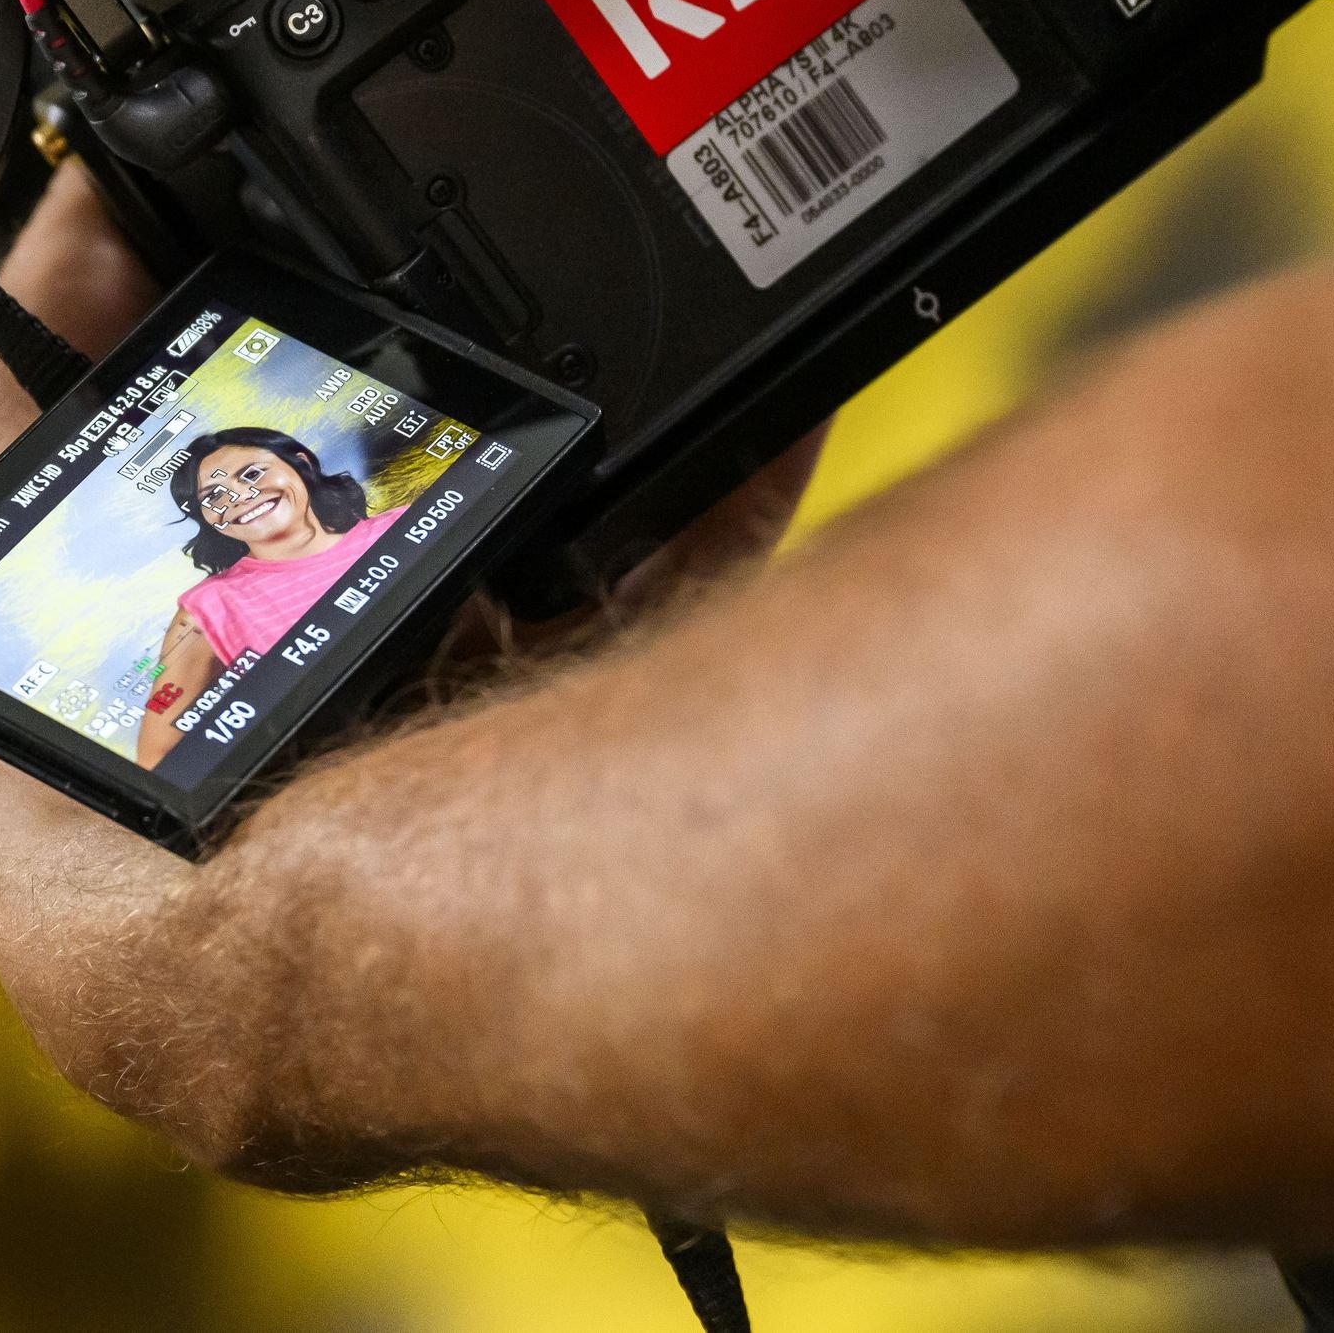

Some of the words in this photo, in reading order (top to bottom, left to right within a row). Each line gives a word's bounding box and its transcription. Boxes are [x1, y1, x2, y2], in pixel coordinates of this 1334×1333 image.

[288, 4, 323, 34] C3
[714, 72, 785, 133] ALPHA
[831, 15, 860, 43] 4K
[728, 87, 798, 148] 707610
[190, 310, 222, 335] 68%
[315, 368, 352, 402] AWB
[351, 387, 378, 412] DRO
[58, 439, 89, 463] 50p
[147, 365, 167, 383] bit
[364, 393, 399, 425] AUTO
[436, 434, 455, 451] PP
[453, 432, 473, 450] OFF
[137, 448, 192, 494] 110mm
[282, 624, 331, 666] F4.5
[18, 664, 53, 695] AF-C
[107, 697, 128, 720] AF
[145, 682, 184, 715] REC
[119, 705, 146, 728] ON
